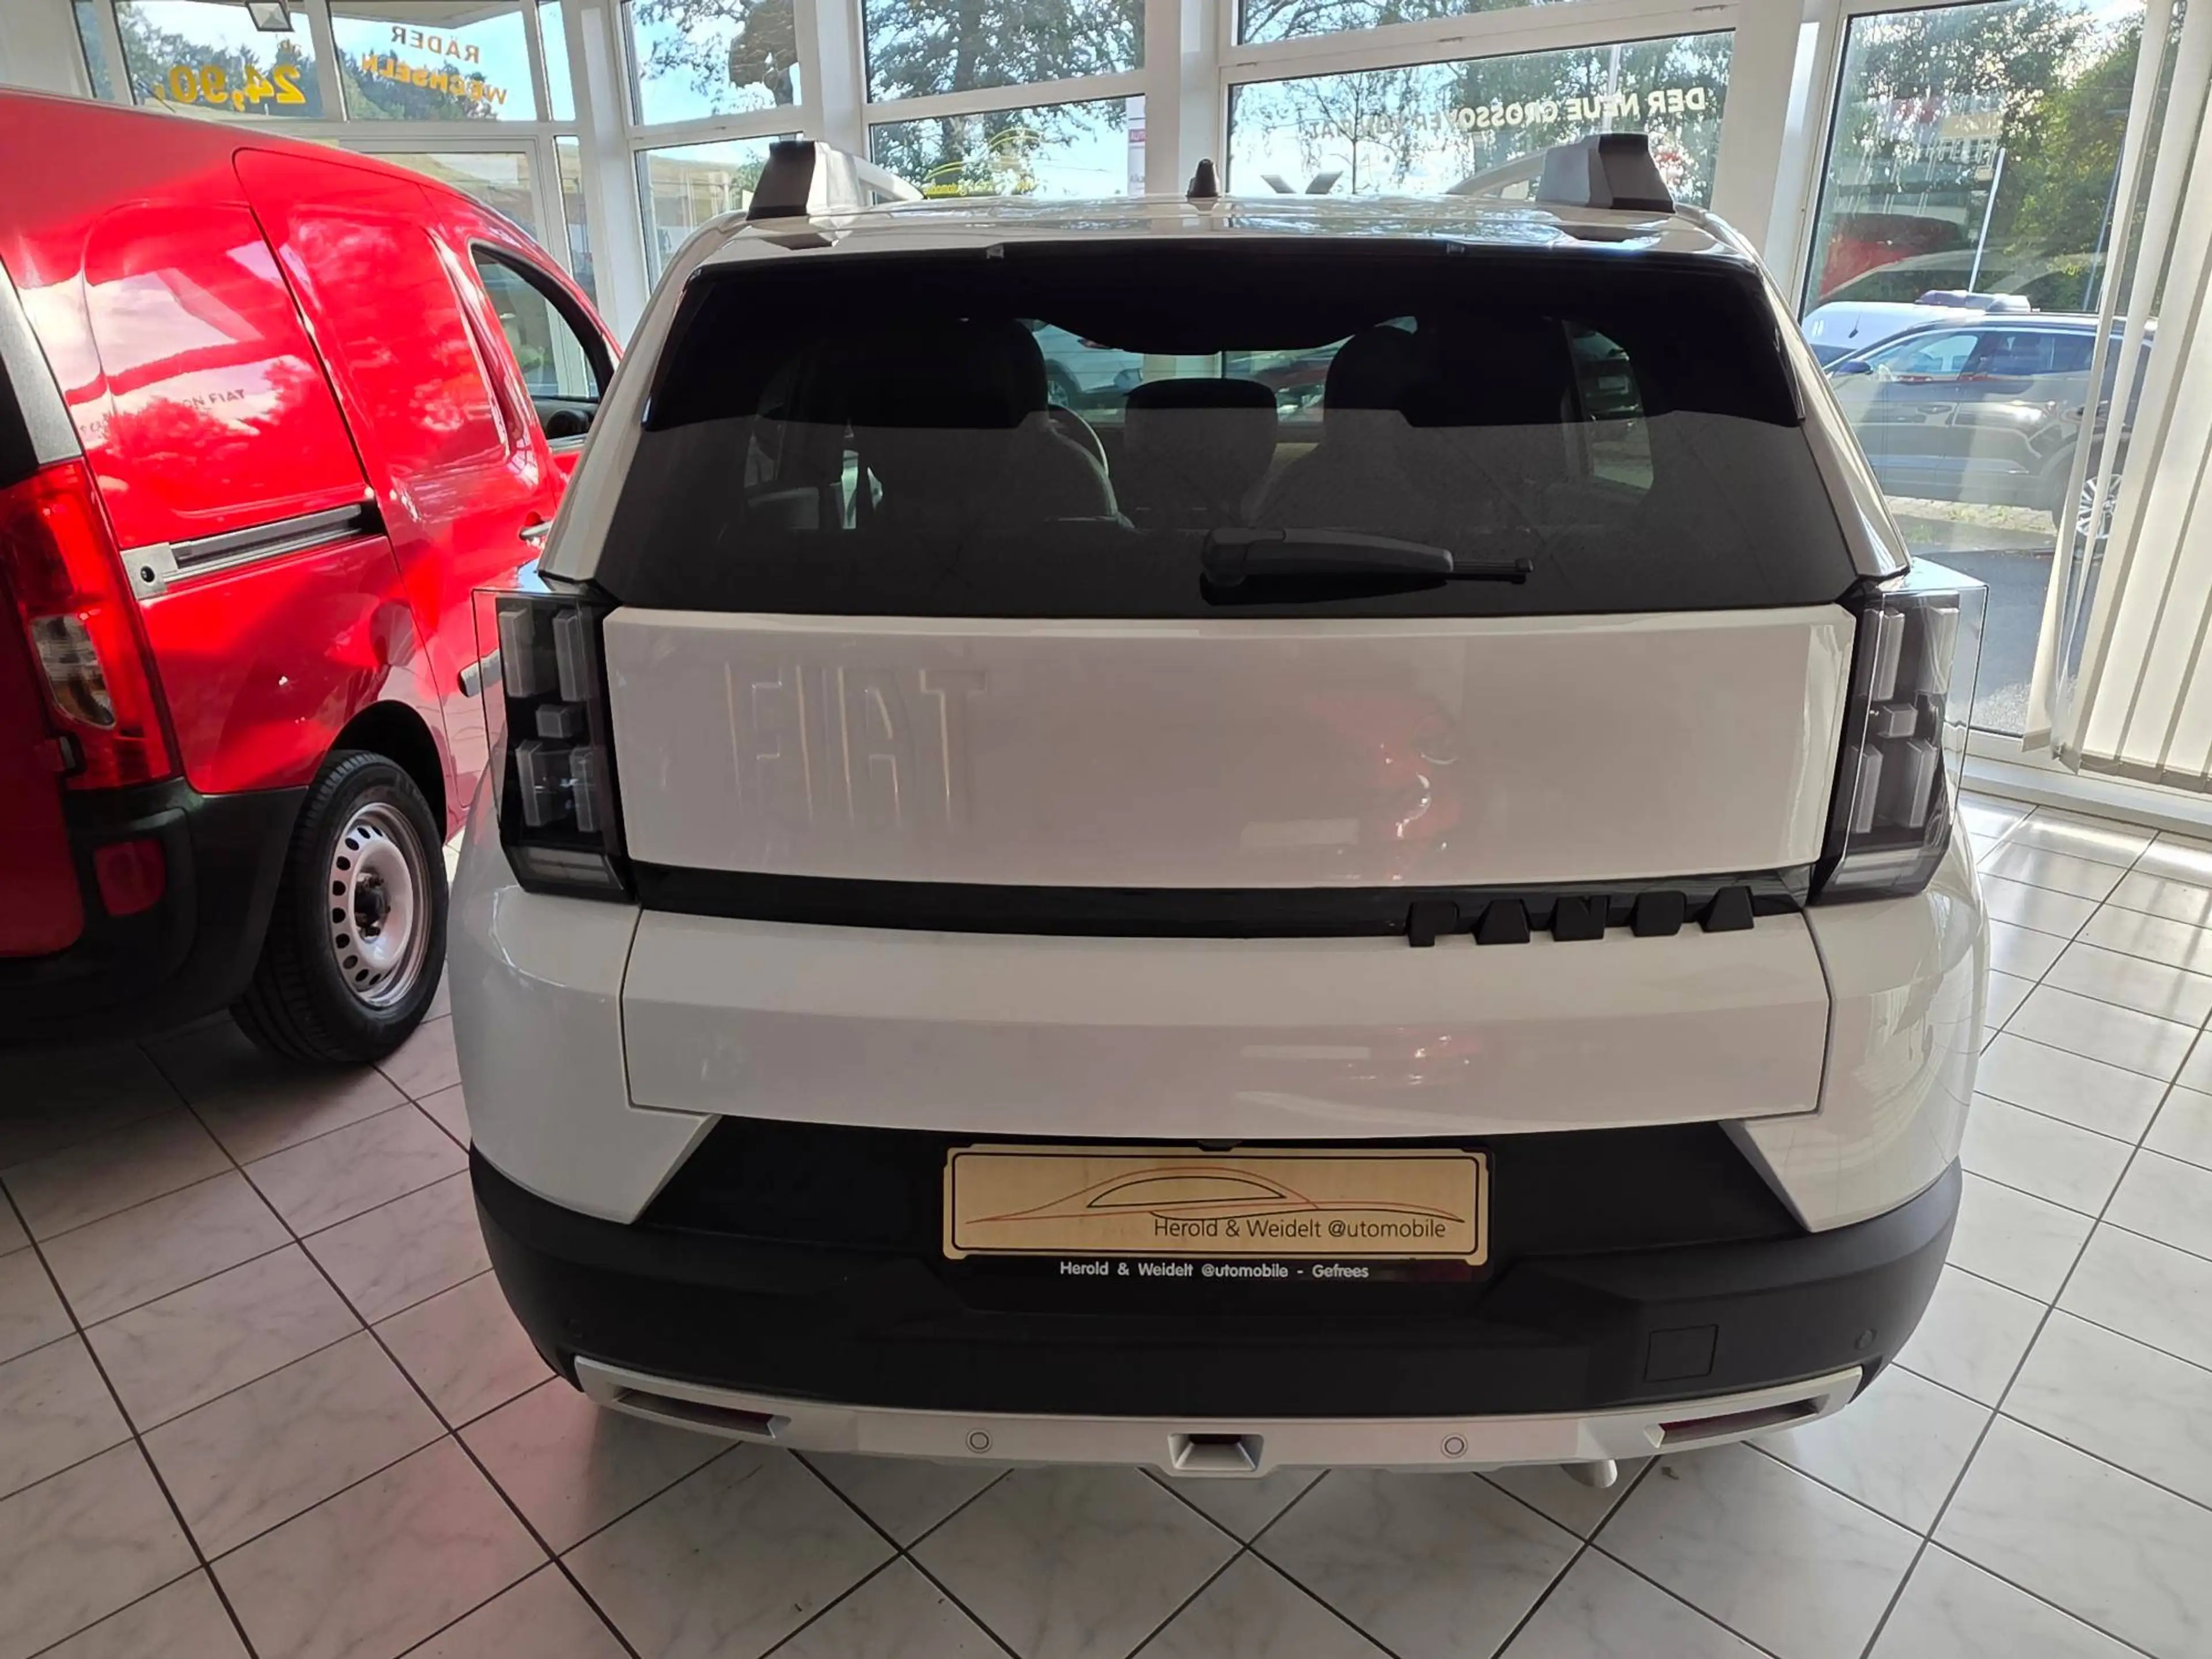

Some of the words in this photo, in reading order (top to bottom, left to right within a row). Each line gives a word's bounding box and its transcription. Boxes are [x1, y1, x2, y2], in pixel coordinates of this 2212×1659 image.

[1154, 1218, 1218, 1237] Herold
[1225, 1218, 1240, 1237] &
[1246, 1218, 1322, 1238] Weidelt
[1328, 1218, 1446, 1238] @utomobile
[1060, 1261, 1109, 1275] Herold
[1116, 1262, 1130, 1277] &
[1137, 1262, 1194, 1277] Weidelt
[1200, 1263, 1289, 1278] @utomobile
[1312, 1263, 1370, 1278] Gefrees
